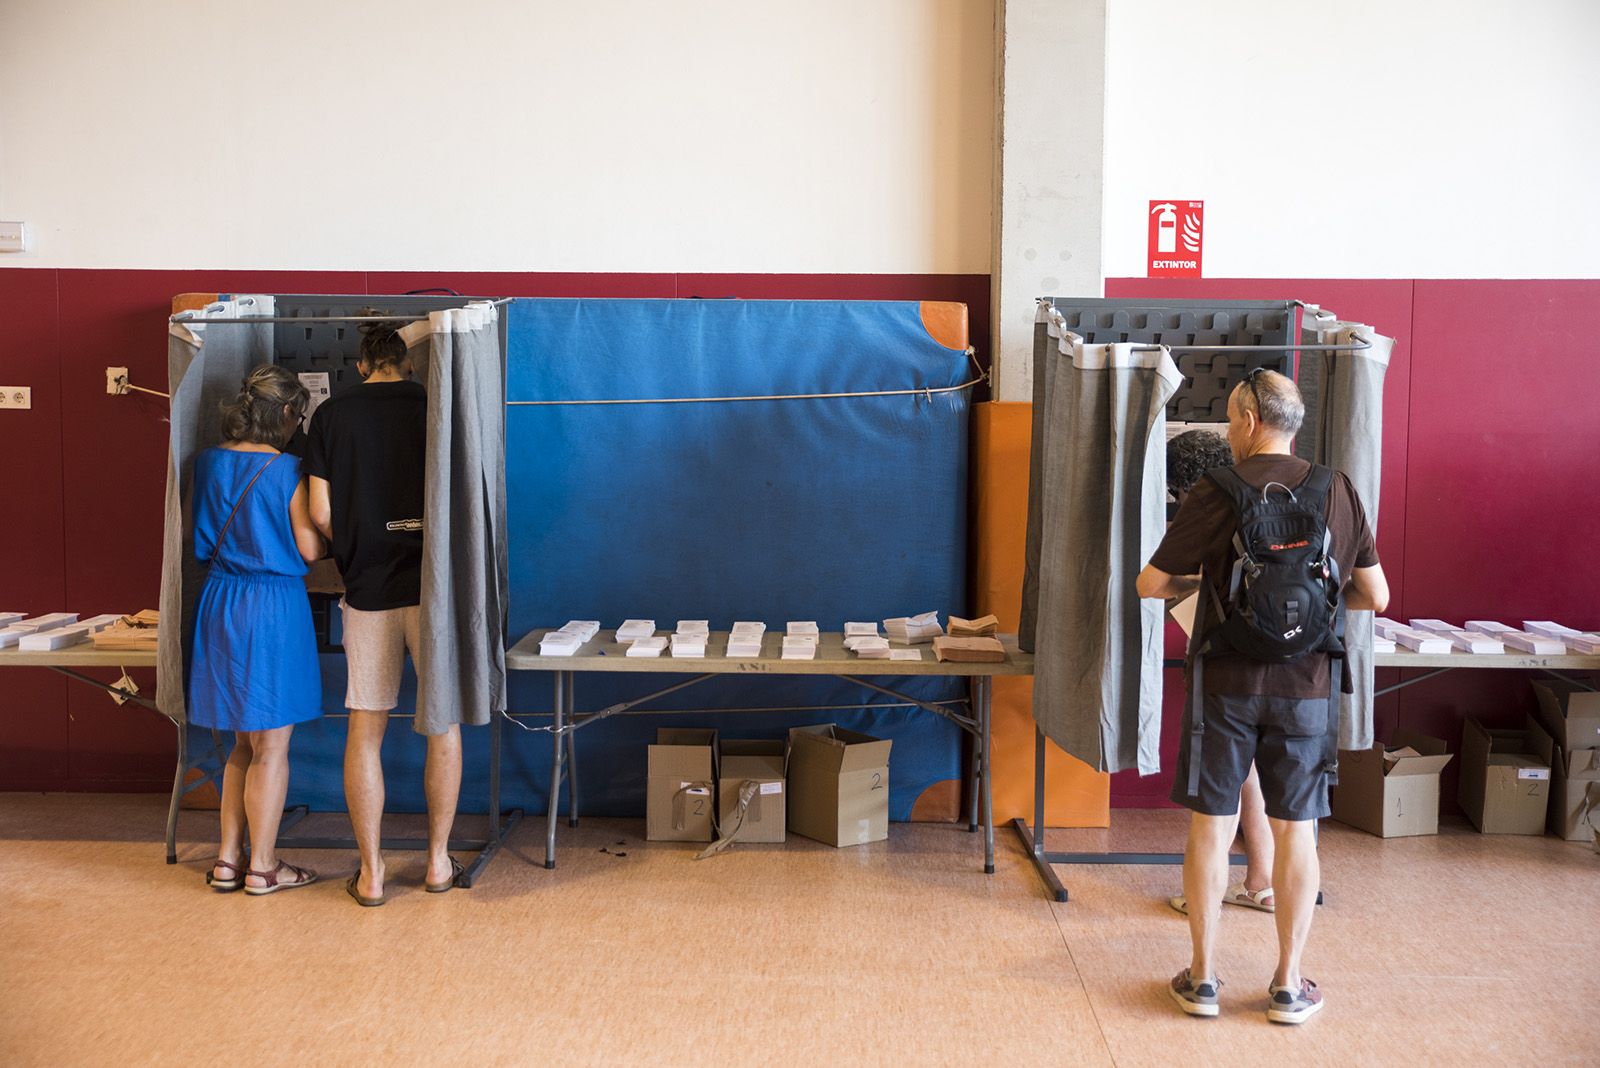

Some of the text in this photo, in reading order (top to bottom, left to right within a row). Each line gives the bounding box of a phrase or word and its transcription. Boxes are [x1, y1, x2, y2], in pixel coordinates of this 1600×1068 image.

[1152, 260, 1197, 269] EXTINTOR
[871, 772, 883, 791] 2
[1527, 783, 1540, 796] 2
[693, 799, 704, 816] 2
